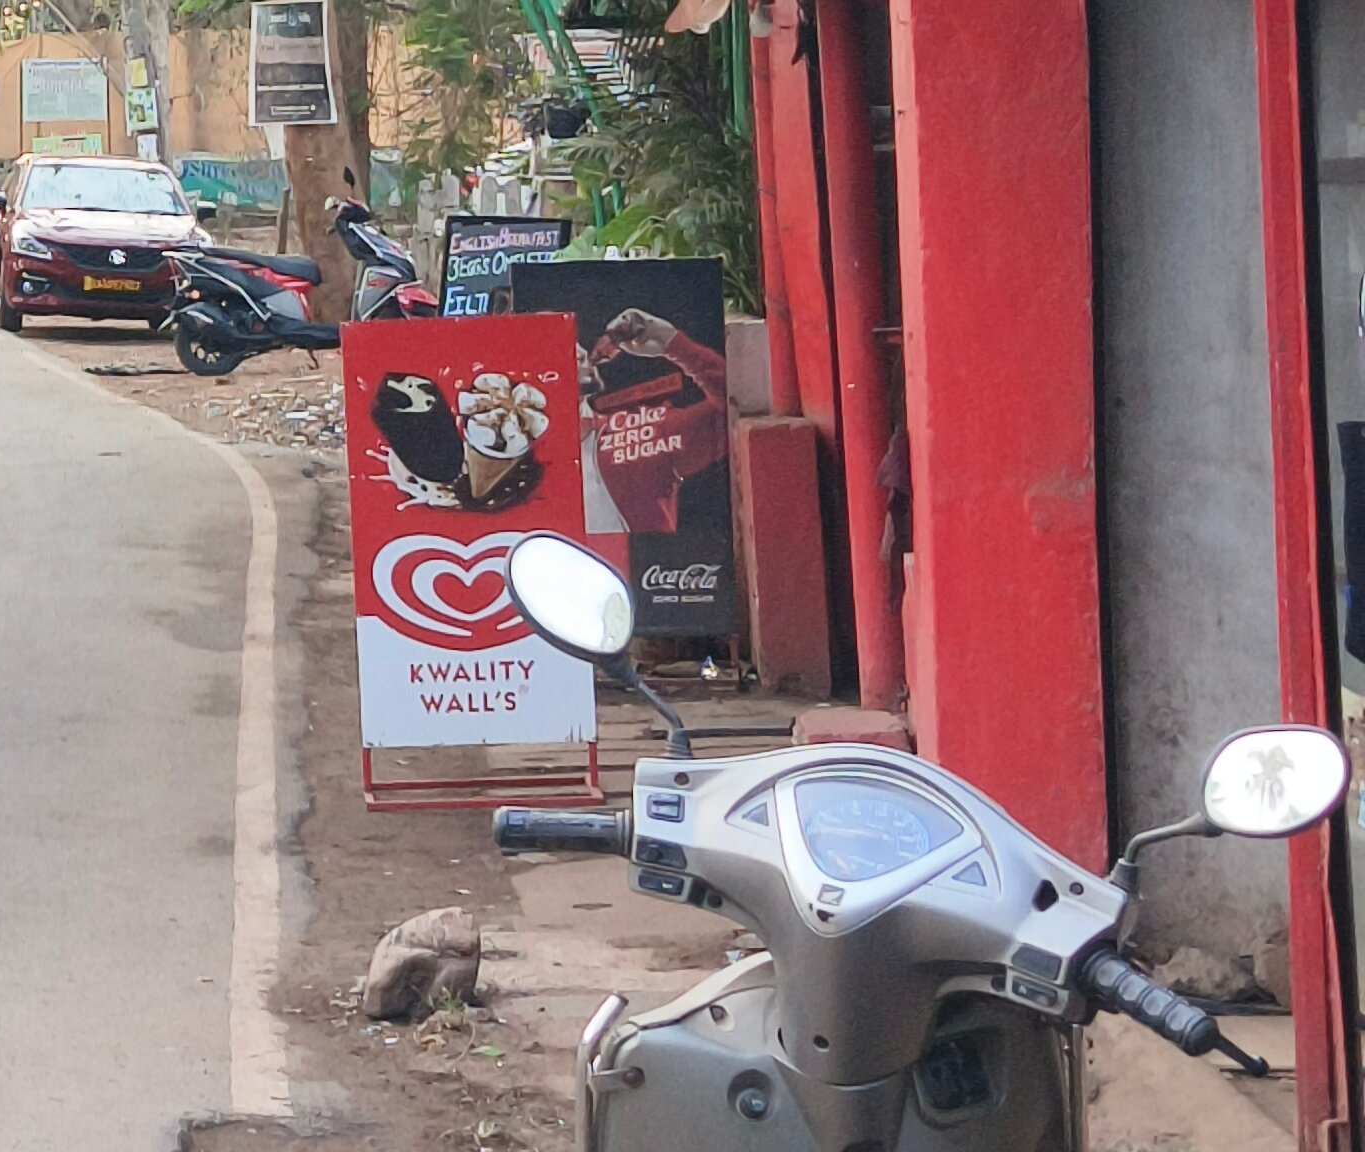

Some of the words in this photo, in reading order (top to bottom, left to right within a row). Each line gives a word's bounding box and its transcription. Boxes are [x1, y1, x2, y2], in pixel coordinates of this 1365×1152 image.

[609, 405, 666, 431] Coke
[600, 425, 654, 451] ZERO
[612, 434, 682, 464] SUGAR
[410, 659, 535, 684] KWALITY
[419, 691, 517, 715] WALL'S
